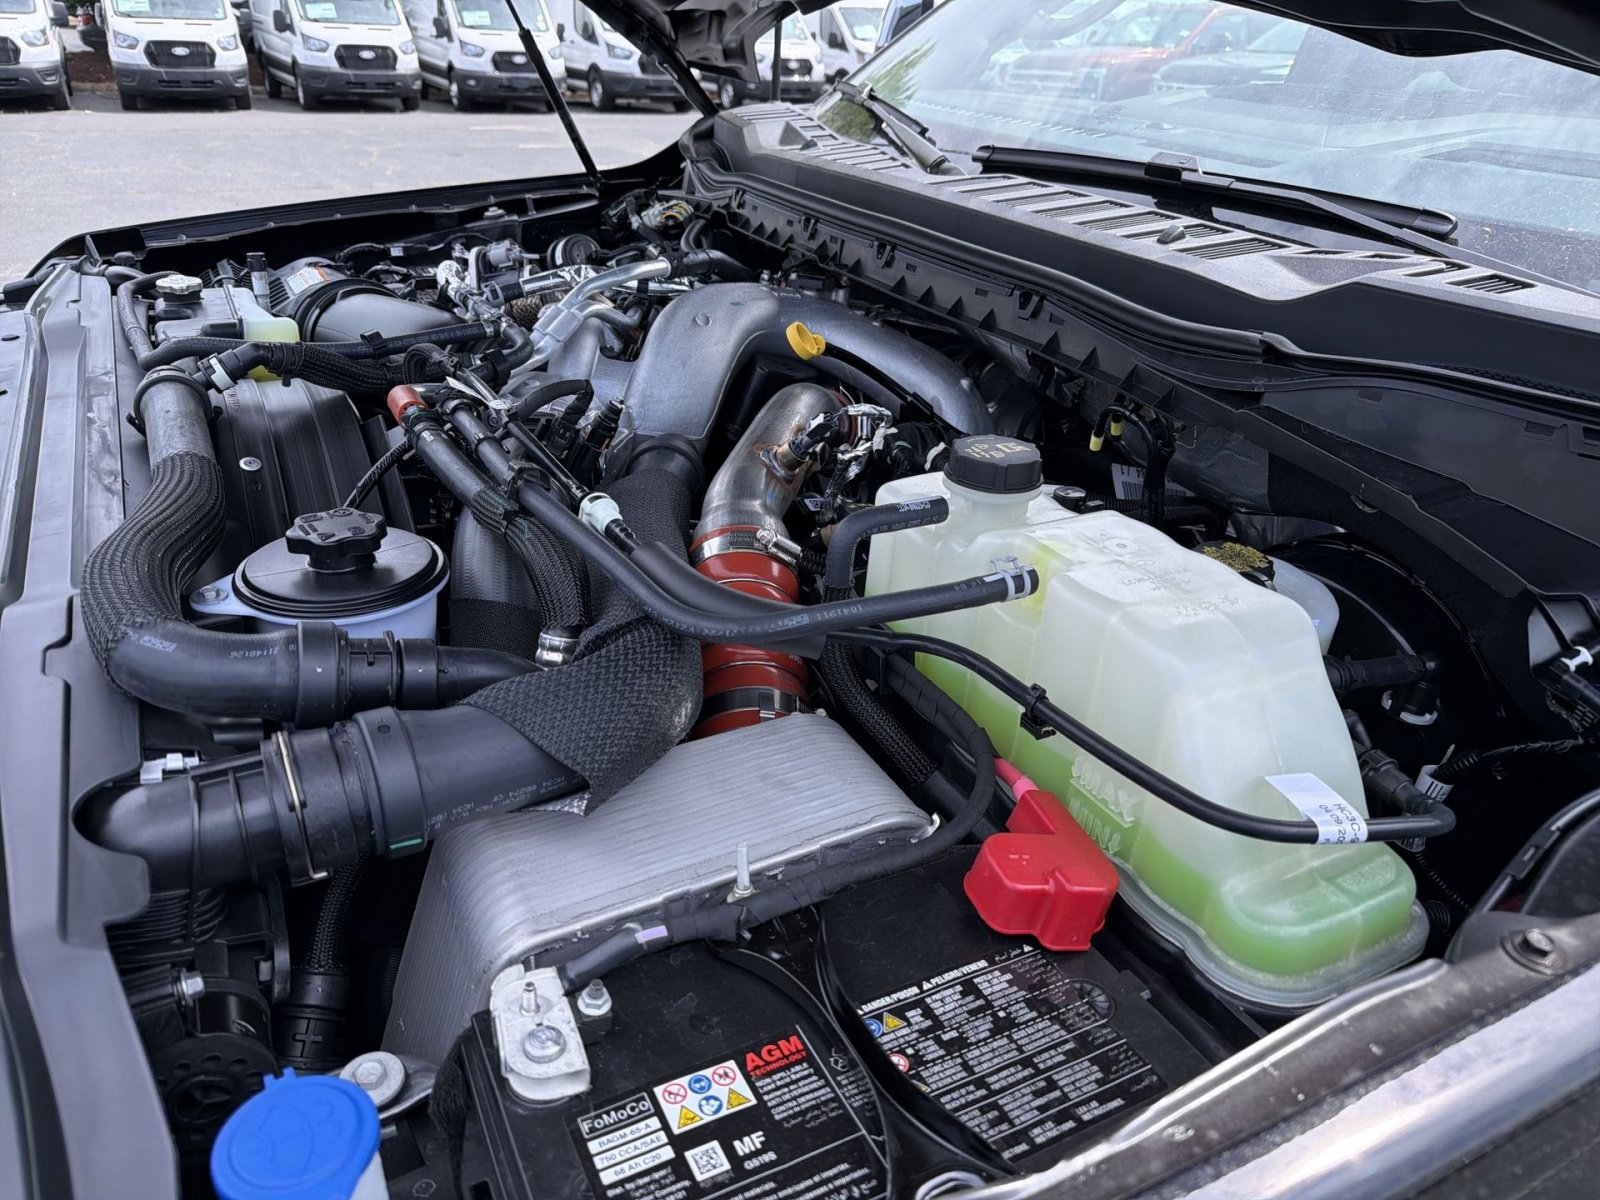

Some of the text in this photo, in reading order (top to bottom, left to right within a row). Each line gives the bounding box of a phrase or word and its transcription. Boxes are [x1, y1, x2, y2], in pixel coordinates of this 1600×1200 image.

[861, 986, 920, 1013] DANGER/POISON
[930, 959, 989, 987] PELIGRO/VENENO
[744, 1034, 805, 1071] AGM
[749, 1050, 808, 1078] TECHNOLOGY
[755, 1062, 809, 1087] NON-SPILLABLE
[790, 1067, 815, 1084] Battery
[582, 1099, 649, 1134] FoMoCo
[598, 1122, 651, 1149] BAGM-65-A
[733, 1130, 766, 1156] MF
[1033, 1119, 1078, 1145] INSTRUCTIONS.
[599, 1135, 663, 1166] 750 CCA/SAE
[743, 1150, 778, 1170] G519S
[613, 1152, 662, 1178] 68 Ah C20
